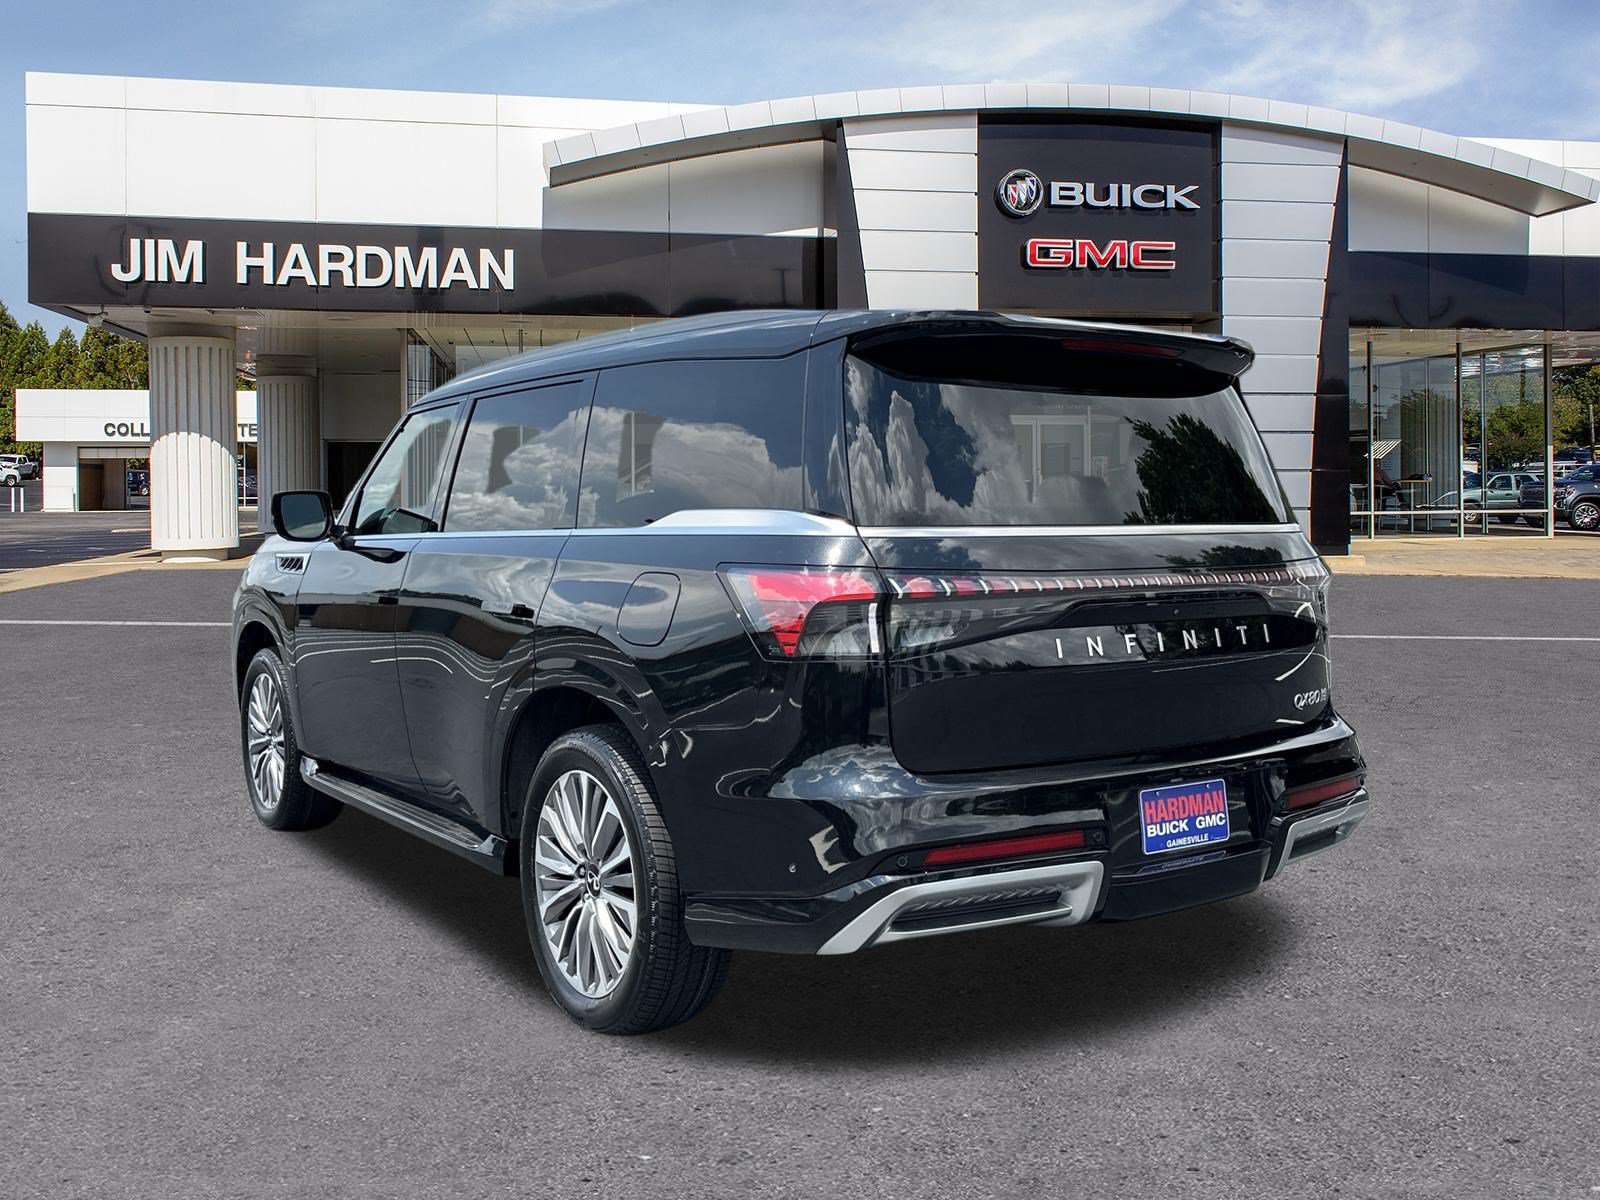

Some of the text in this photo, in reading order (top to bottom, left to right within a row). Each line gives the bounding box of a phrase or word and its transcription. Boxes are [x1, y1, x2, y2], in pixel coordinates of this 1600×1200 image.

[1050, 181, 1200, 209] BUICK
[111, 238, 514, 290] JIM HARDMAN
[1026, 238, 1176, 270] GMC
[1055, 623, 1269, 658] INFINITI
[1294, 689, 1320, 710] QX80
[1144, 790, 1225, 824] HARDMAN
[1146, 813, 1226, 838] BUICK GMC
[1166, 833, 1209, 848] GAINESVILLE
